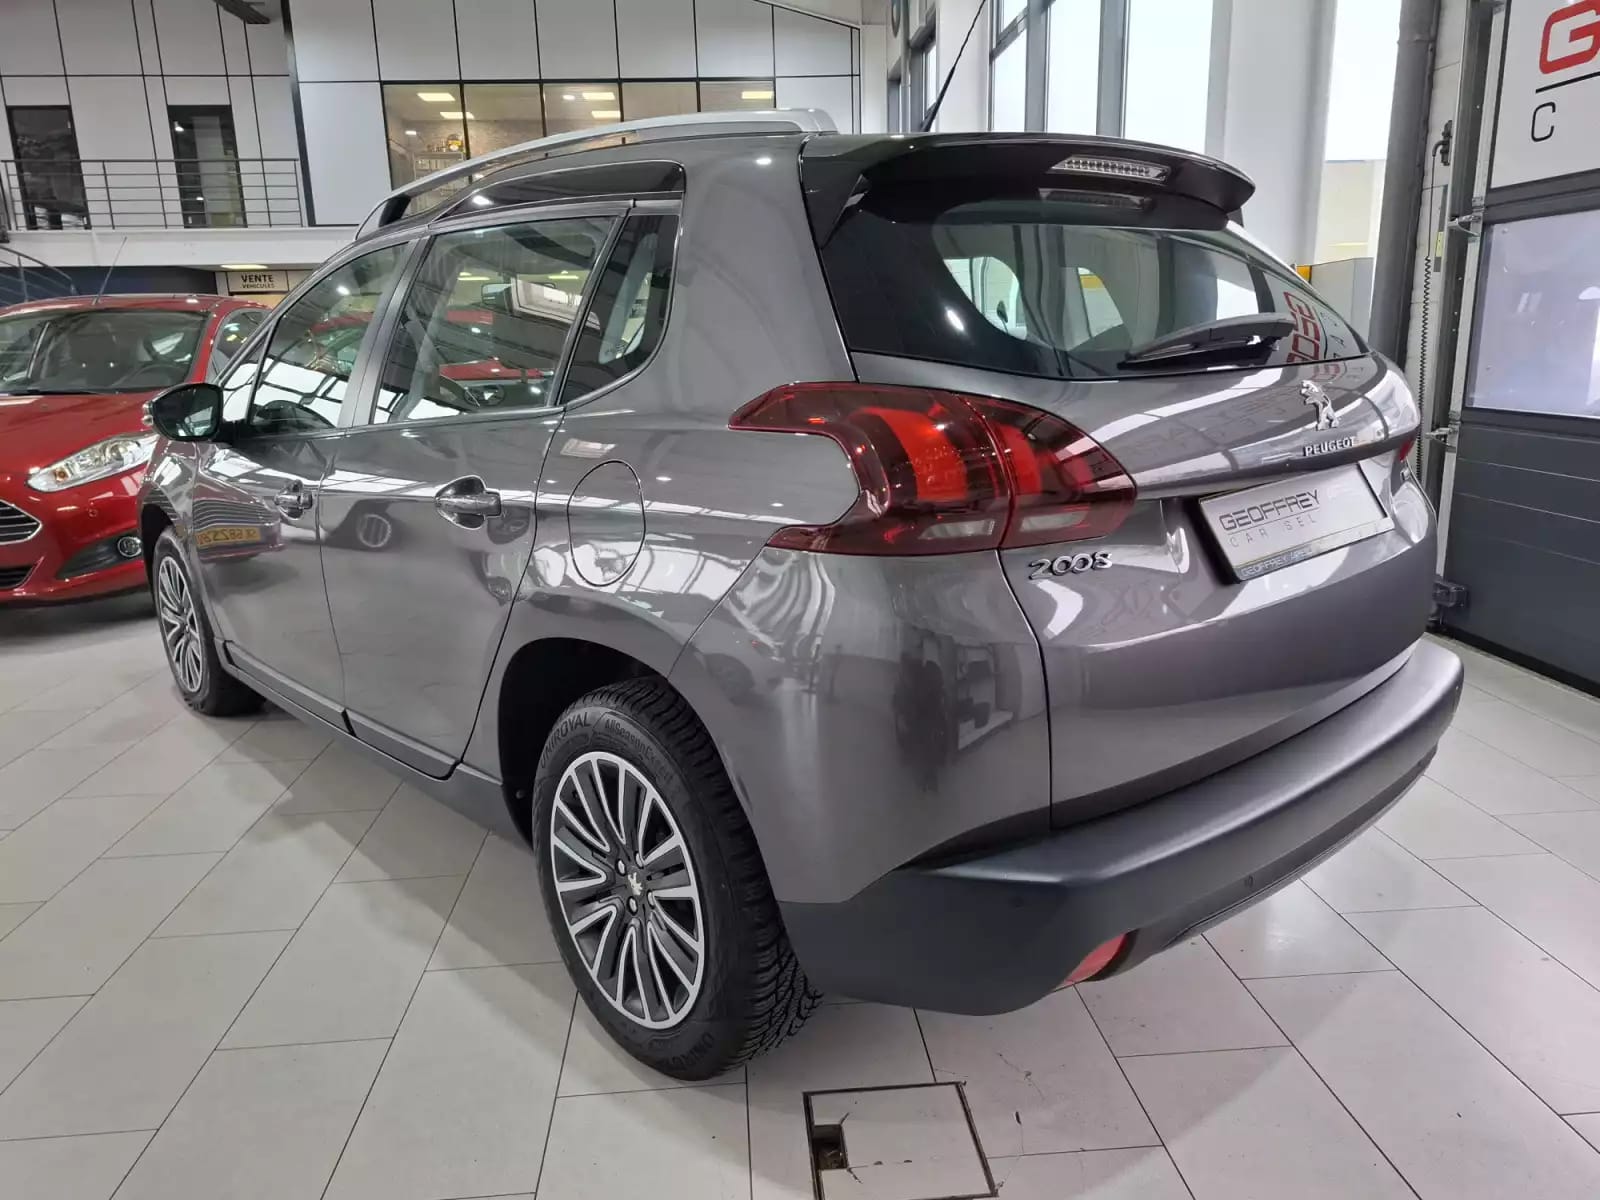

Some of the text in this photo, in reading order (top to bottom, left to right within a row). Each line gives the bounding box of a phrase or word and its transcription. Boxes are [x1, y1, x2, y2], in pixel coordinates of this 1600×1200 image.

[241, 274, 274, 283] VENTE
[1303, 436, 1357, 457] PEUGEOT
[1219, 489, 1320, 531] GEOFFREY
[1230, 514, 1317, 547] CAR SEL
[1028, 550, 1113, 580] 2008
[540, 711, 592, 769] UNIROYAL
